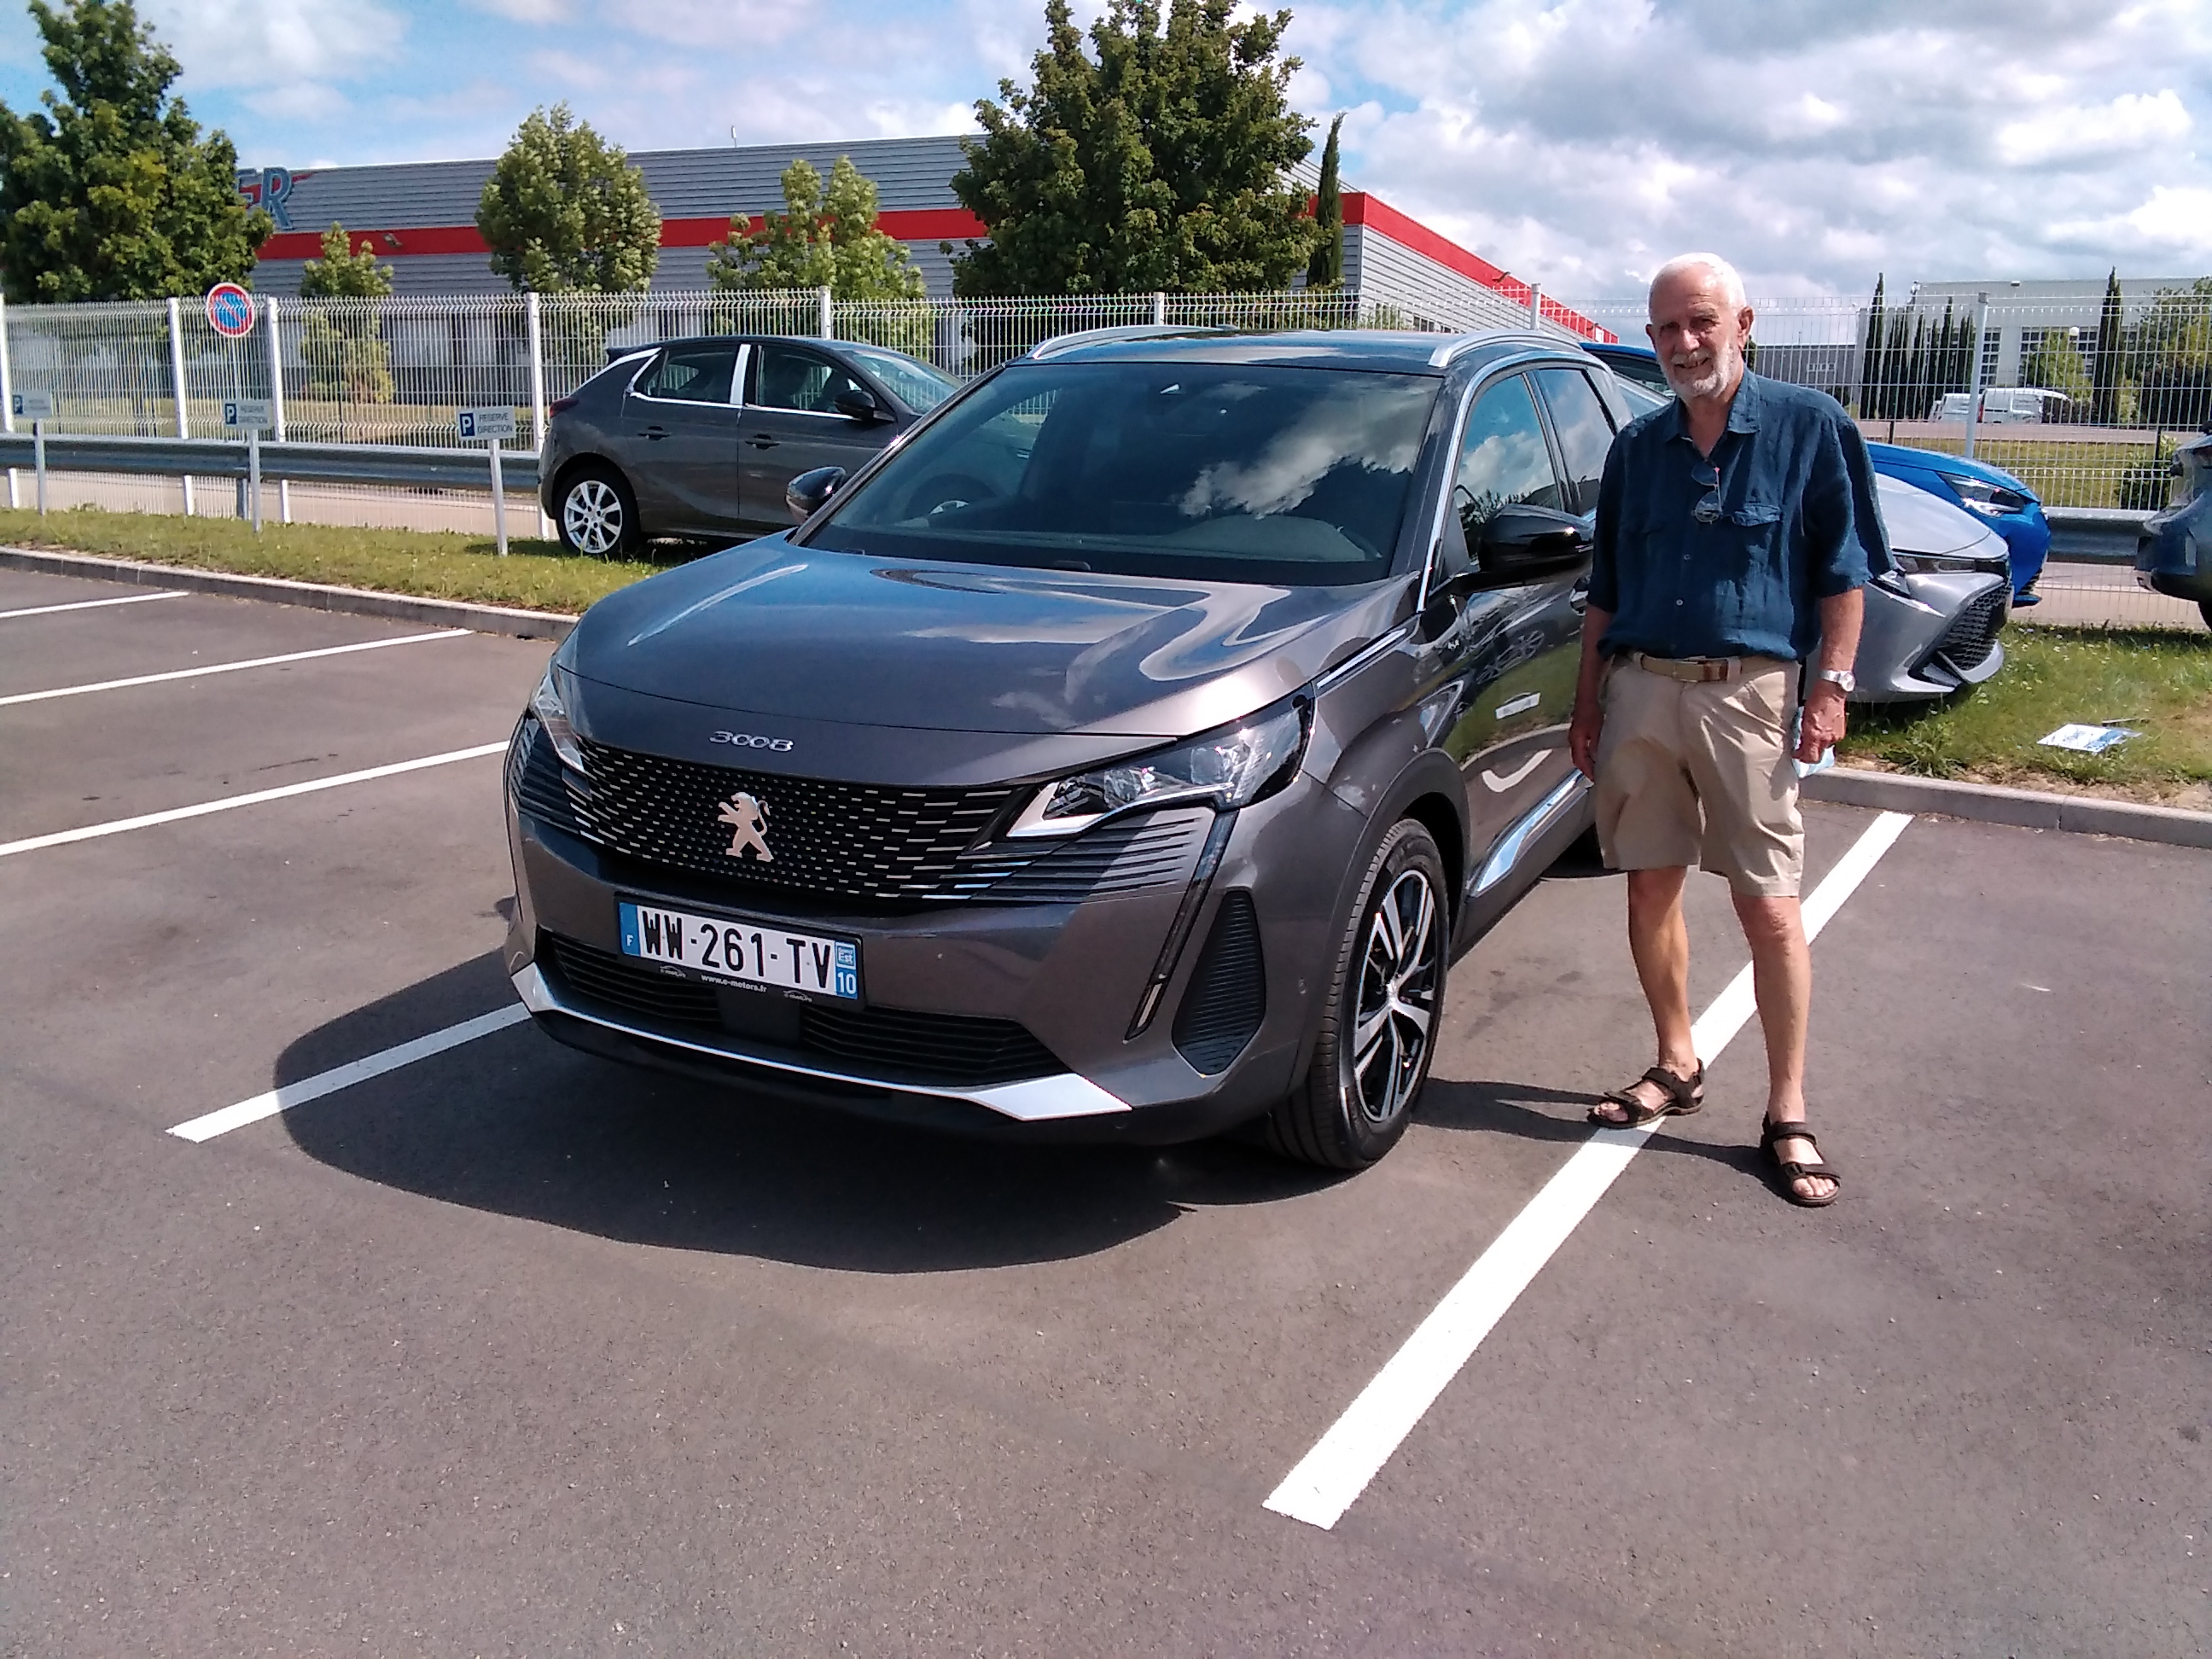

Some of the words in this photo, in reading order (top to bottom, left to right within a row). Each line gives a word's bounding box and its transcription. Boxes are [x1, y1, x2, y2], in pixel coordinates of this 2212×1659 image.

[461, 416, 472, 434] P
[478, 425, 513, 434] DIRECTION
[709, 731, 794, 752] 3008
[626, 934, 634, 946] F
[838, 952, 853, 964] Est
[701, 974, 767, 992] www.e-motors.fr
[837, 972, 857, 995] 10
